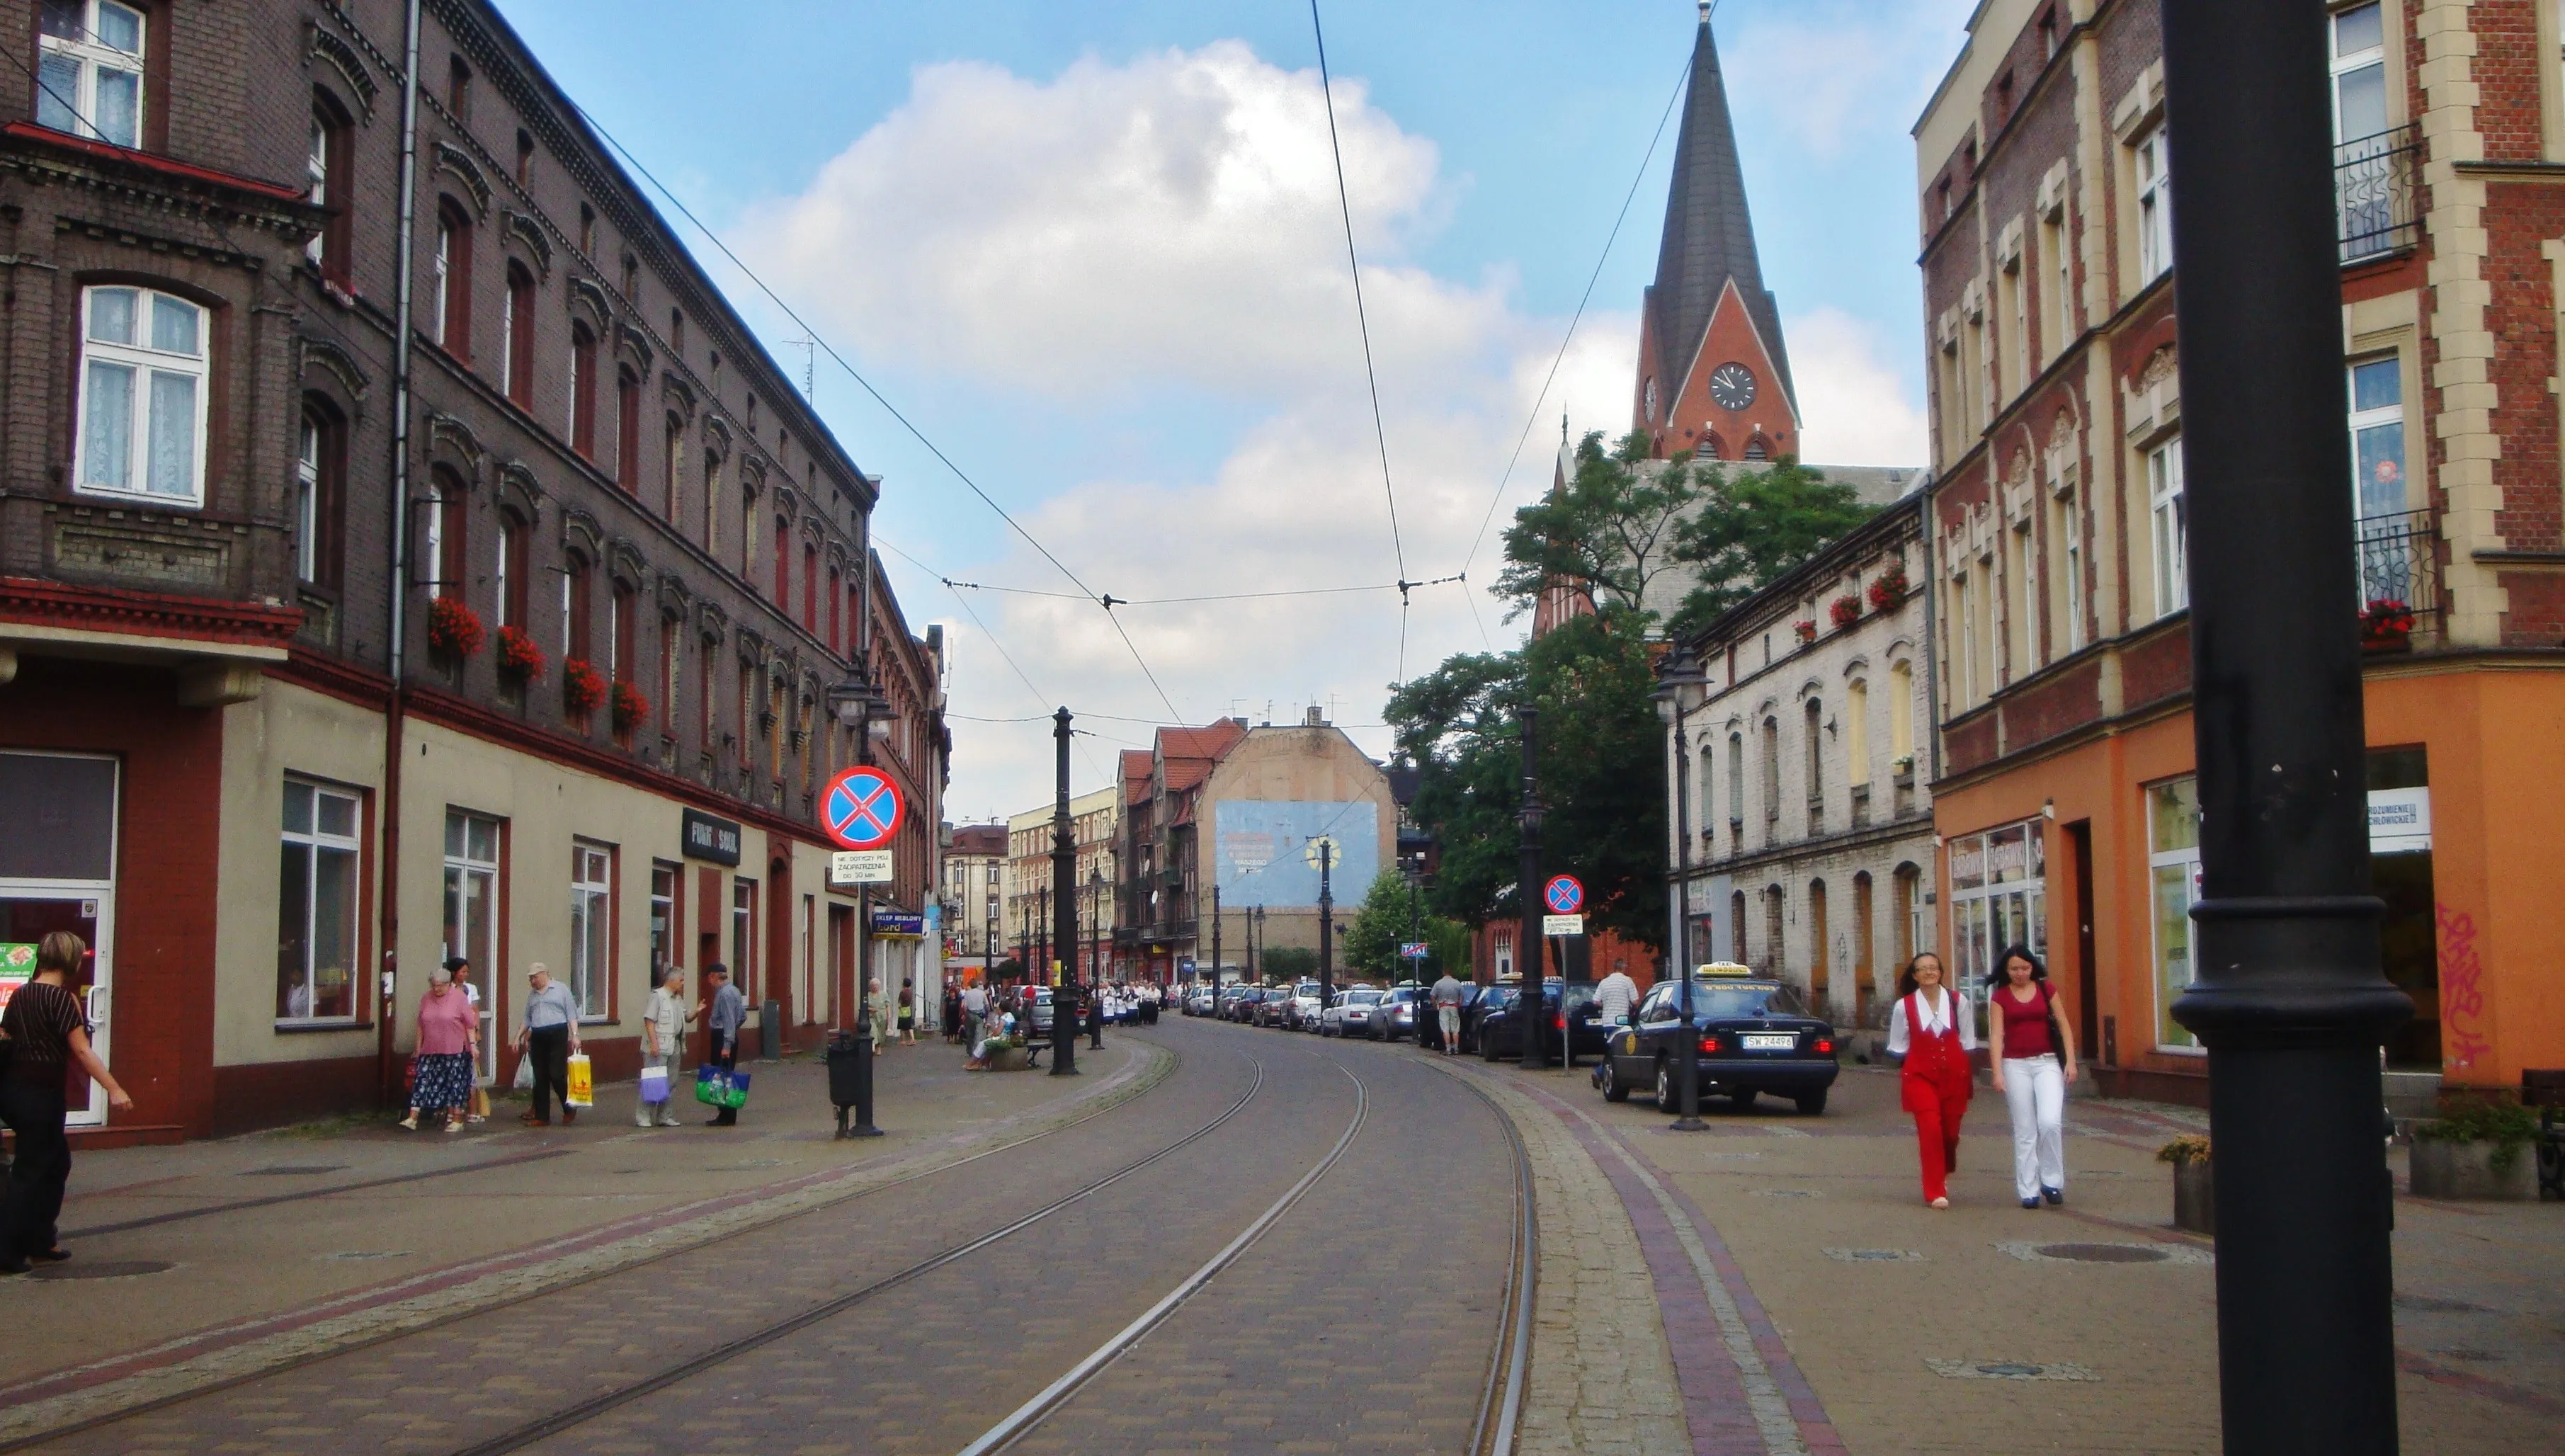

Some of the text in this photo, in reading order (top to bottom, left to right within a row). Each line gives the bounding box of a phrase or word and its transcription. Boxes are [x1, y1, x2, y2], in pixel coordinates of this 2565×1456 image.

[719, 829, 737, 853] SOUL
[1402, 945, 1425, 955] TAXI
[1748, 1037, 1792, 1046] SW 24496
